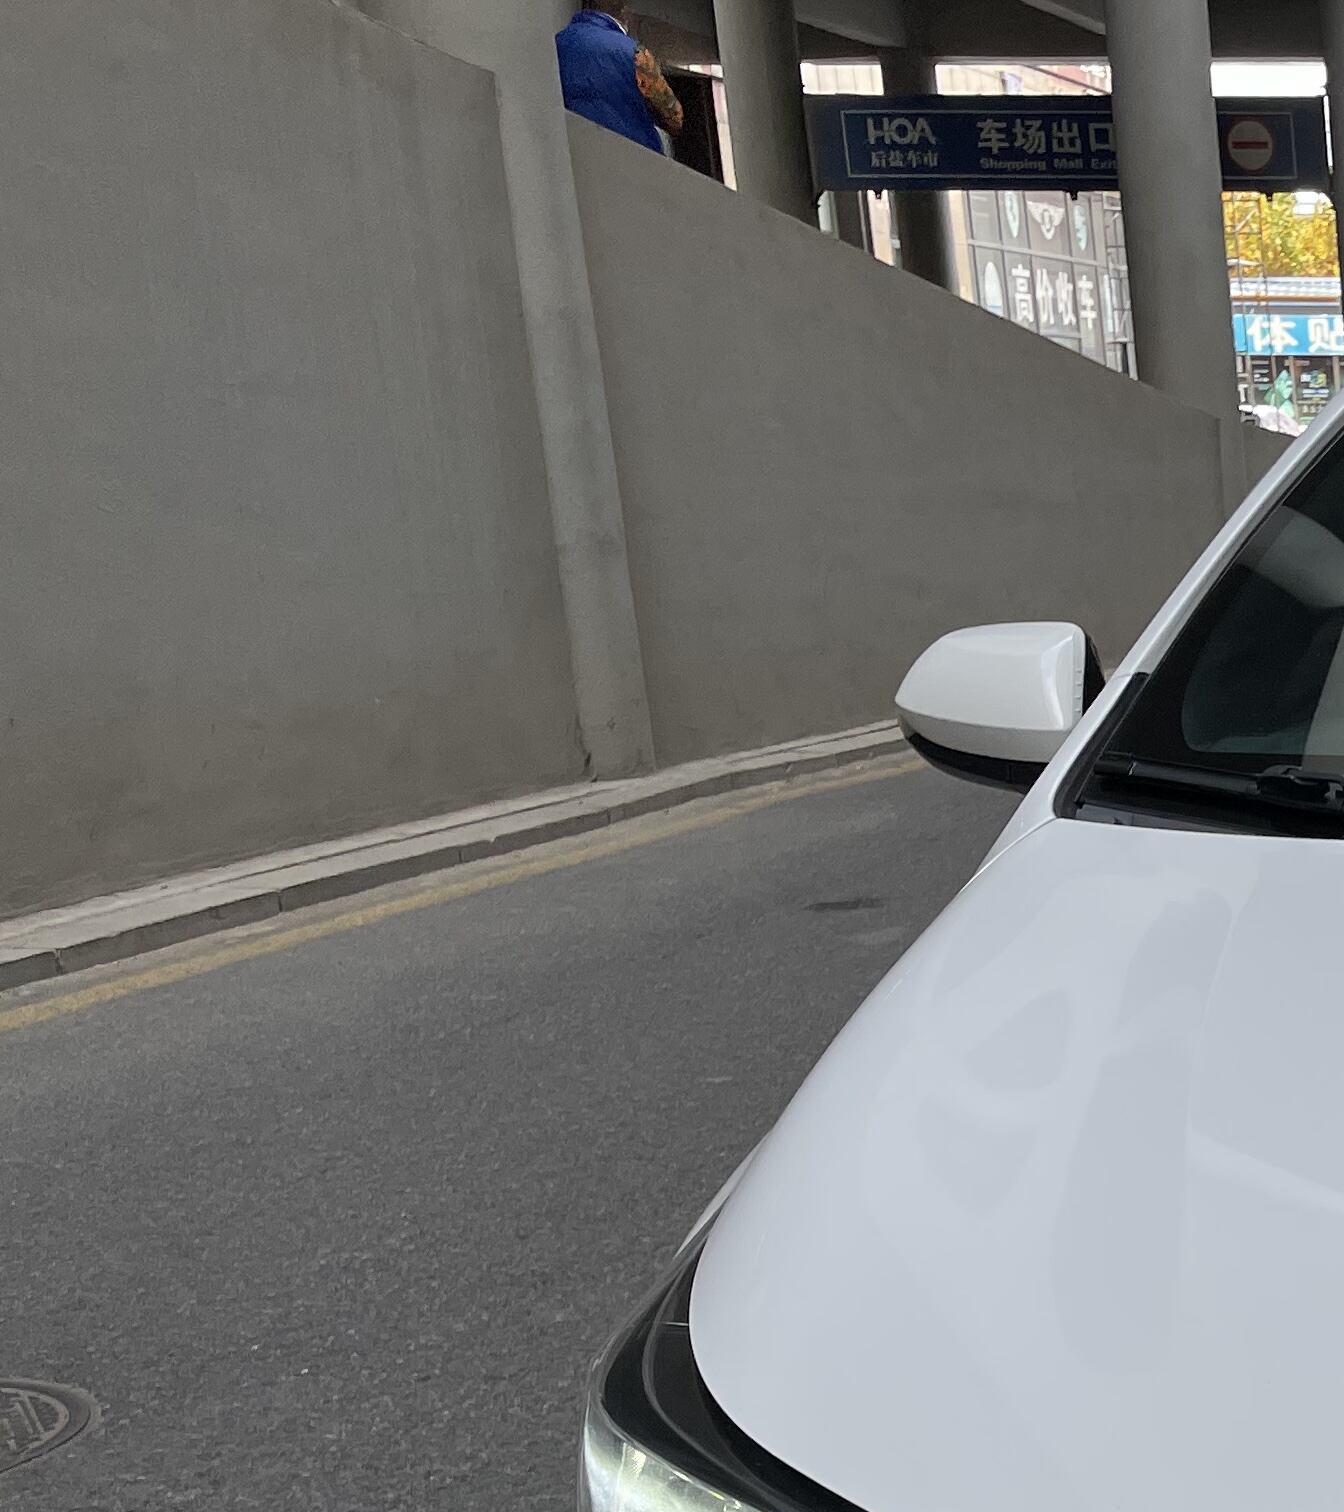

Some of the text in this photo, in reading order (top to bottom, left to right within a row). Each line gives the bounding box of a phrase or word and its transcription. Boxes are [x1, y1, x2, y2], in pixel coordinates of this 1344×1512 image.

[867, 117, 937, 145] HOA
[976, 118, 1117, 155] 车场出口
[980, 158, 1047, 171] Shopping
[1053, 158, 1084, 169] Mall
[1011, 264, 1097, 330] 高价收车
